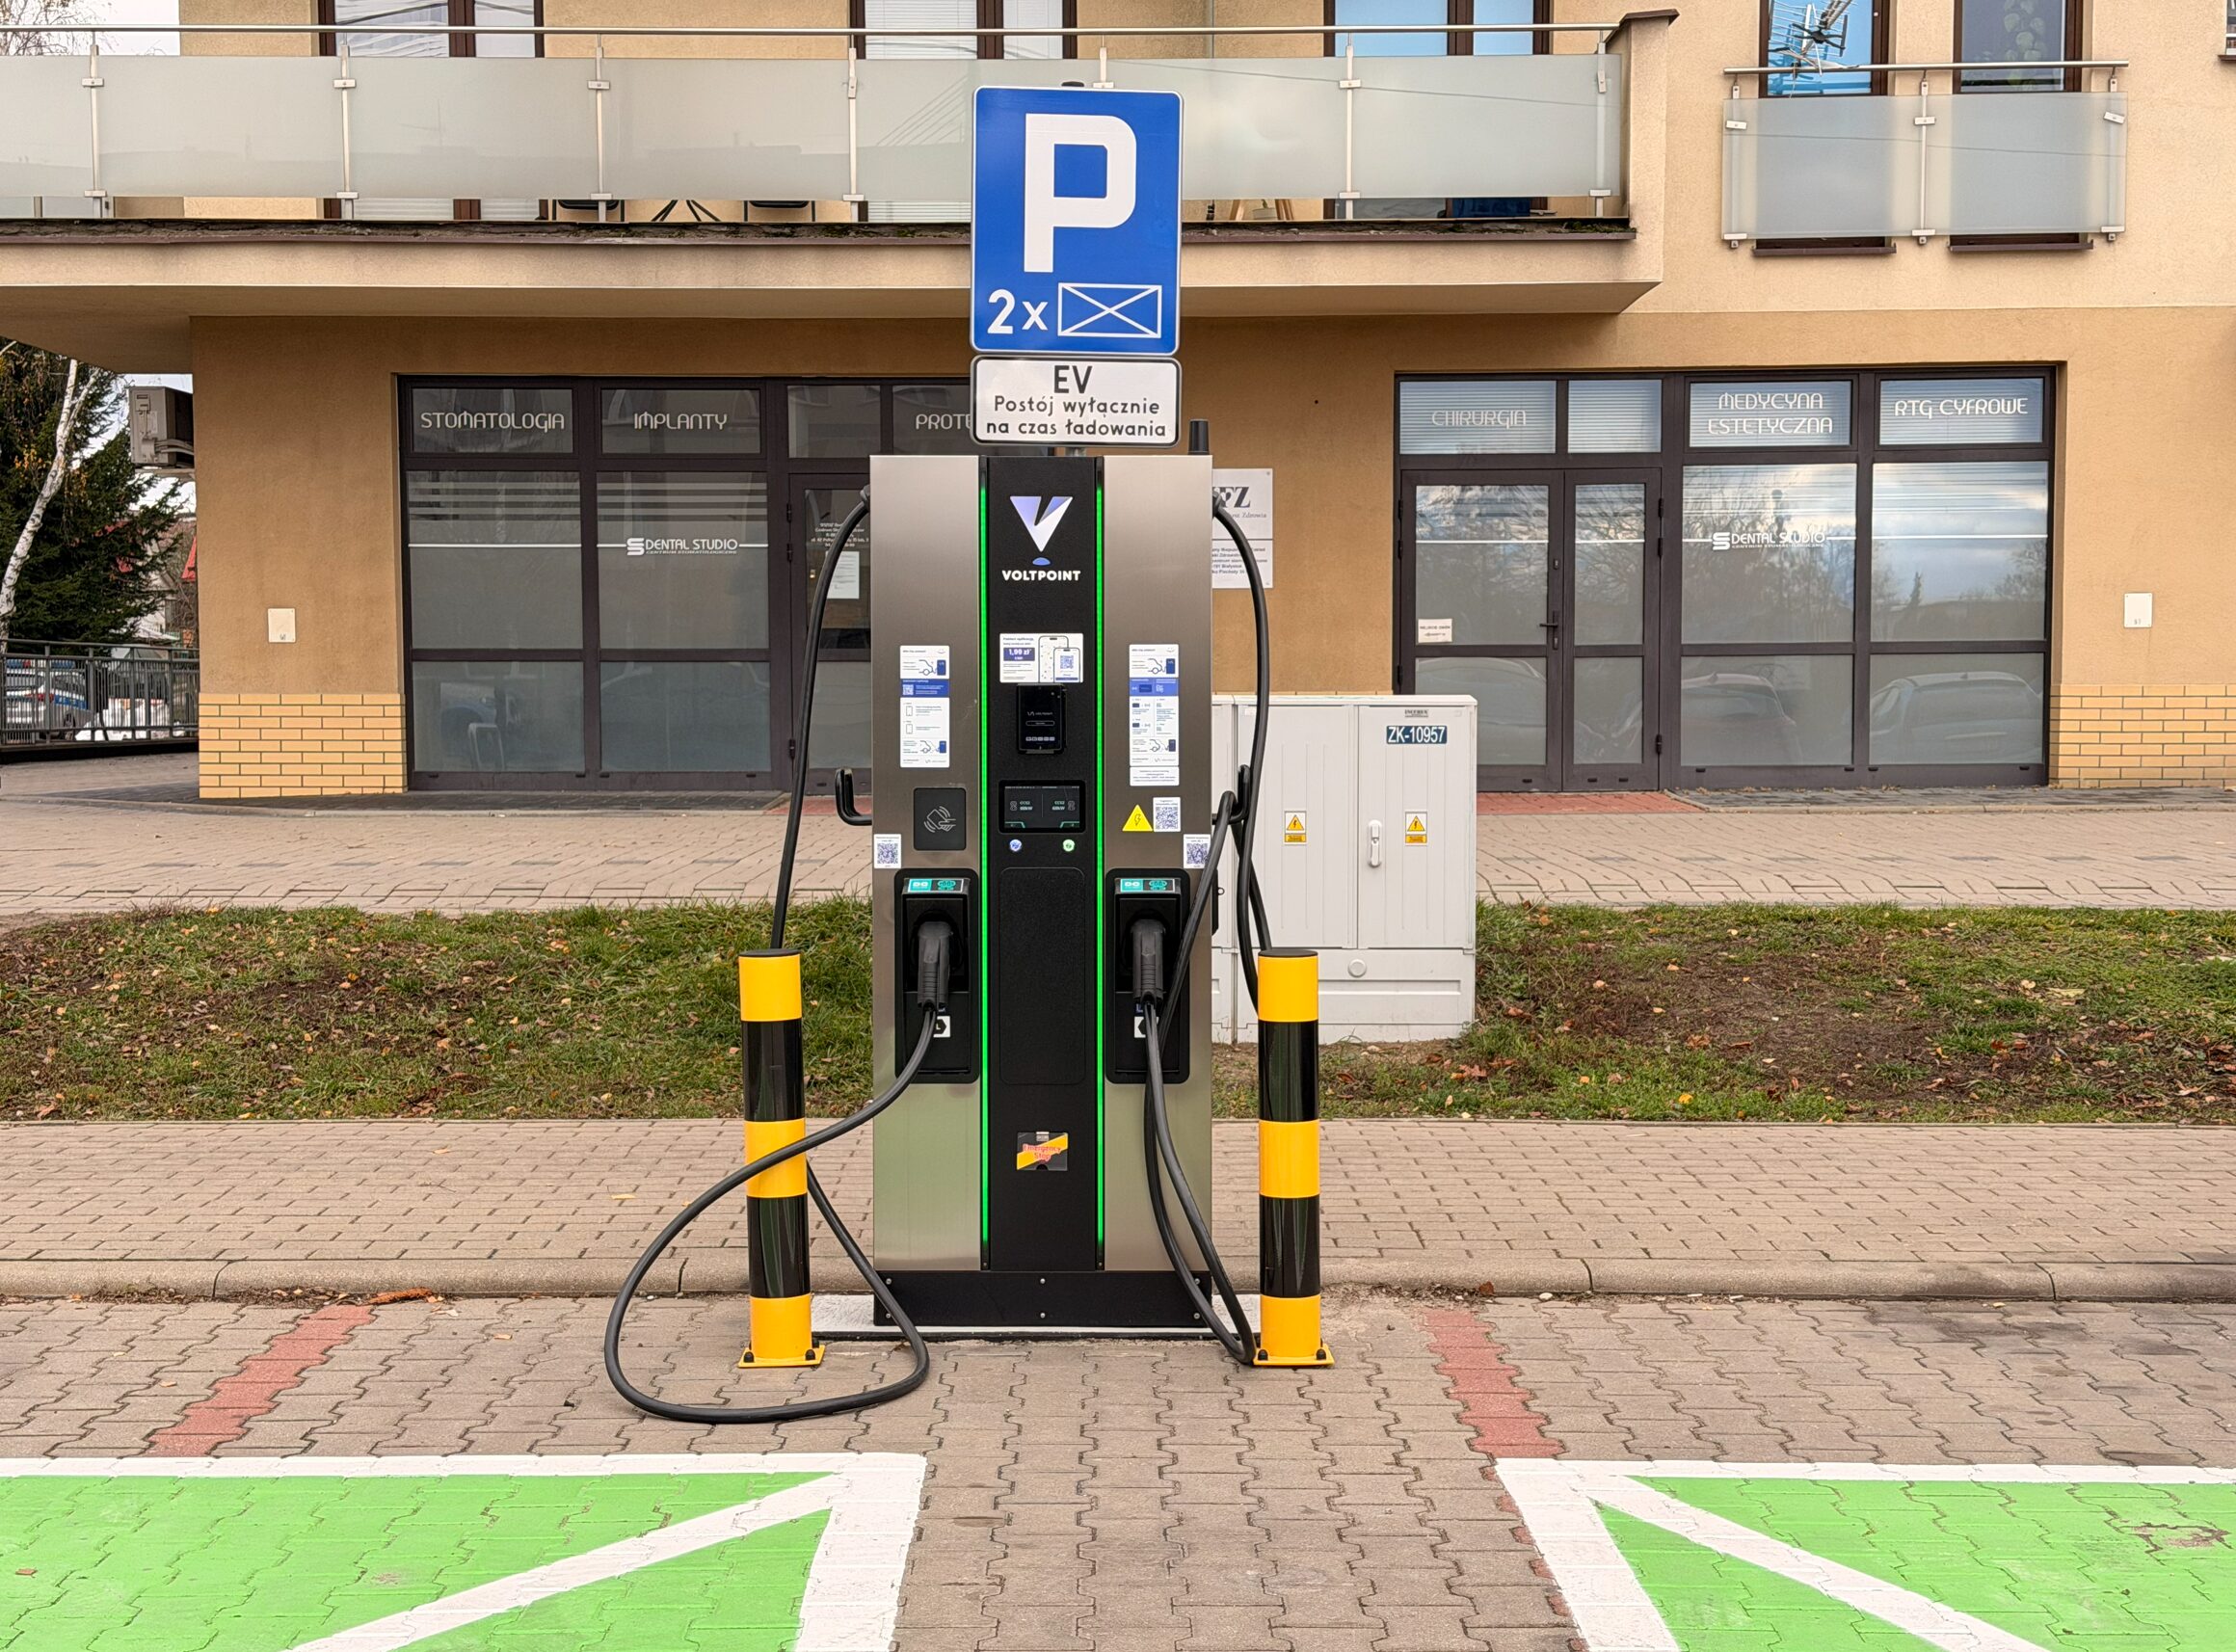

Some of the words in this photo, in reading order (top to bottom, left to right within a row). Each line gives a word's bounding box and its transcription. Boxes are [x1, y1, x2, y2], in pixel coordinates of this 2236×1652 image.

[1024, 113, 1137, 273] P
[1053, 365, 1093, 394] EV
[994, 395, 1054, 417] Postój
[1062, 396, 1160, 418] wyłącznie
[1717, 391, 1823, 410] MEDYCYNA
[1894, 399, 1933, 419] RTG
[1939, 397, 2029, 415] CYFROWE
[420, 412, 565, 433] STOMATOLOGIA
[633, 412, 728, 430] IMPLANTY
[986, 421, 1009, 435] na
[1018, 422, 1057, 435] czas
[1065, 418, 1166, 437] ładowania
[1431, 410, 1527, 430] CHIRURGIA
[1707, 417, 1833, 435] ESTETYCZNA
[645, 539, 690, 550] DENTAL
[692, 539, 738, 550] STUDIO
[1731, 533, 1776, 545] DENTAL
[1778, 531, 1825, 544] STUDIO
[1001, 570, 1081, 581] VOLTPOINT
[1388, 726, 1446, 743] ZK-10957
